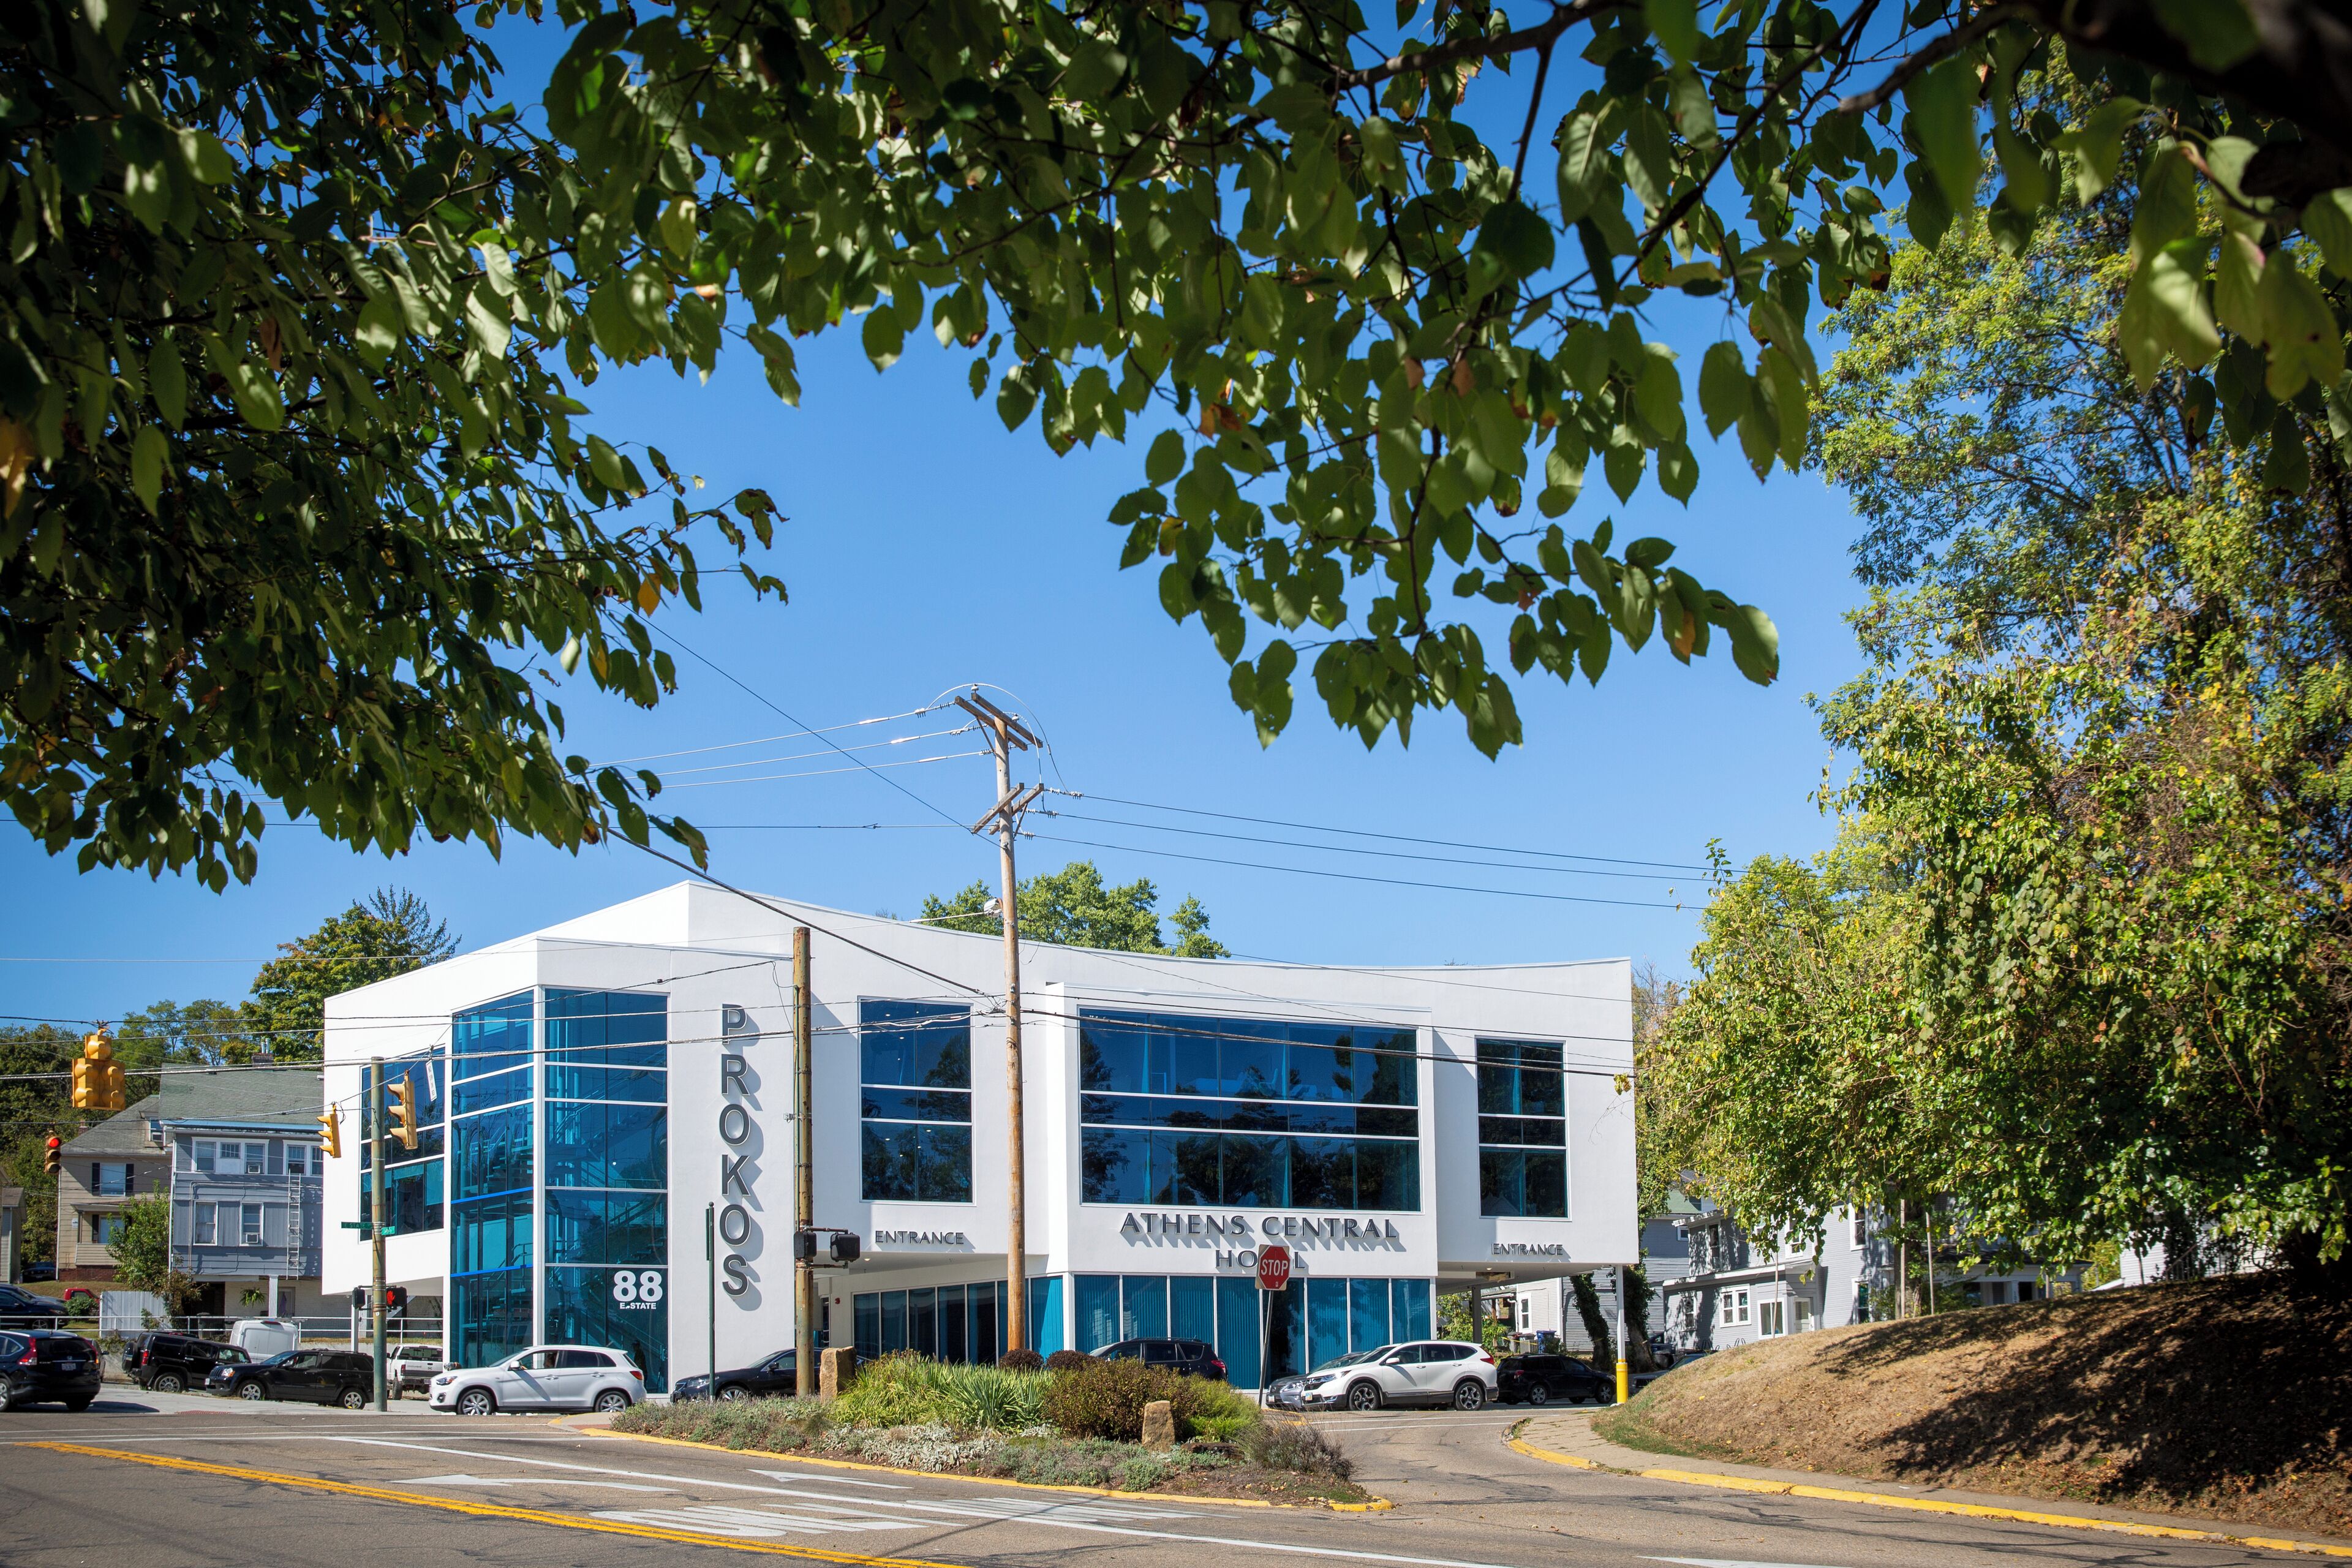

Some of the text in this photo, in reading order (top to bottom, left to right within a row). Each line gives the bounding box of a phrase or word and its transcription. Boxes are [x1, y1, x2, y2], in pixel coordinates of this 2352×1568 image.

[719, 1004, 750, 1296] PROKOS
[1120, 1212, 1397, 1238] ATHENS CENTRAL
[875, 1230, 964, 1245] ENTRANCE
[1216, 1250, 1305, 1269] HOL
[1491, 1243, 1563, 1256] ENTRANCE
[1261, 1259, 1288, 1276] STOP
[613, 1270, 663, 1302] 88
[589, 1503, 968, 1536] ONLY
